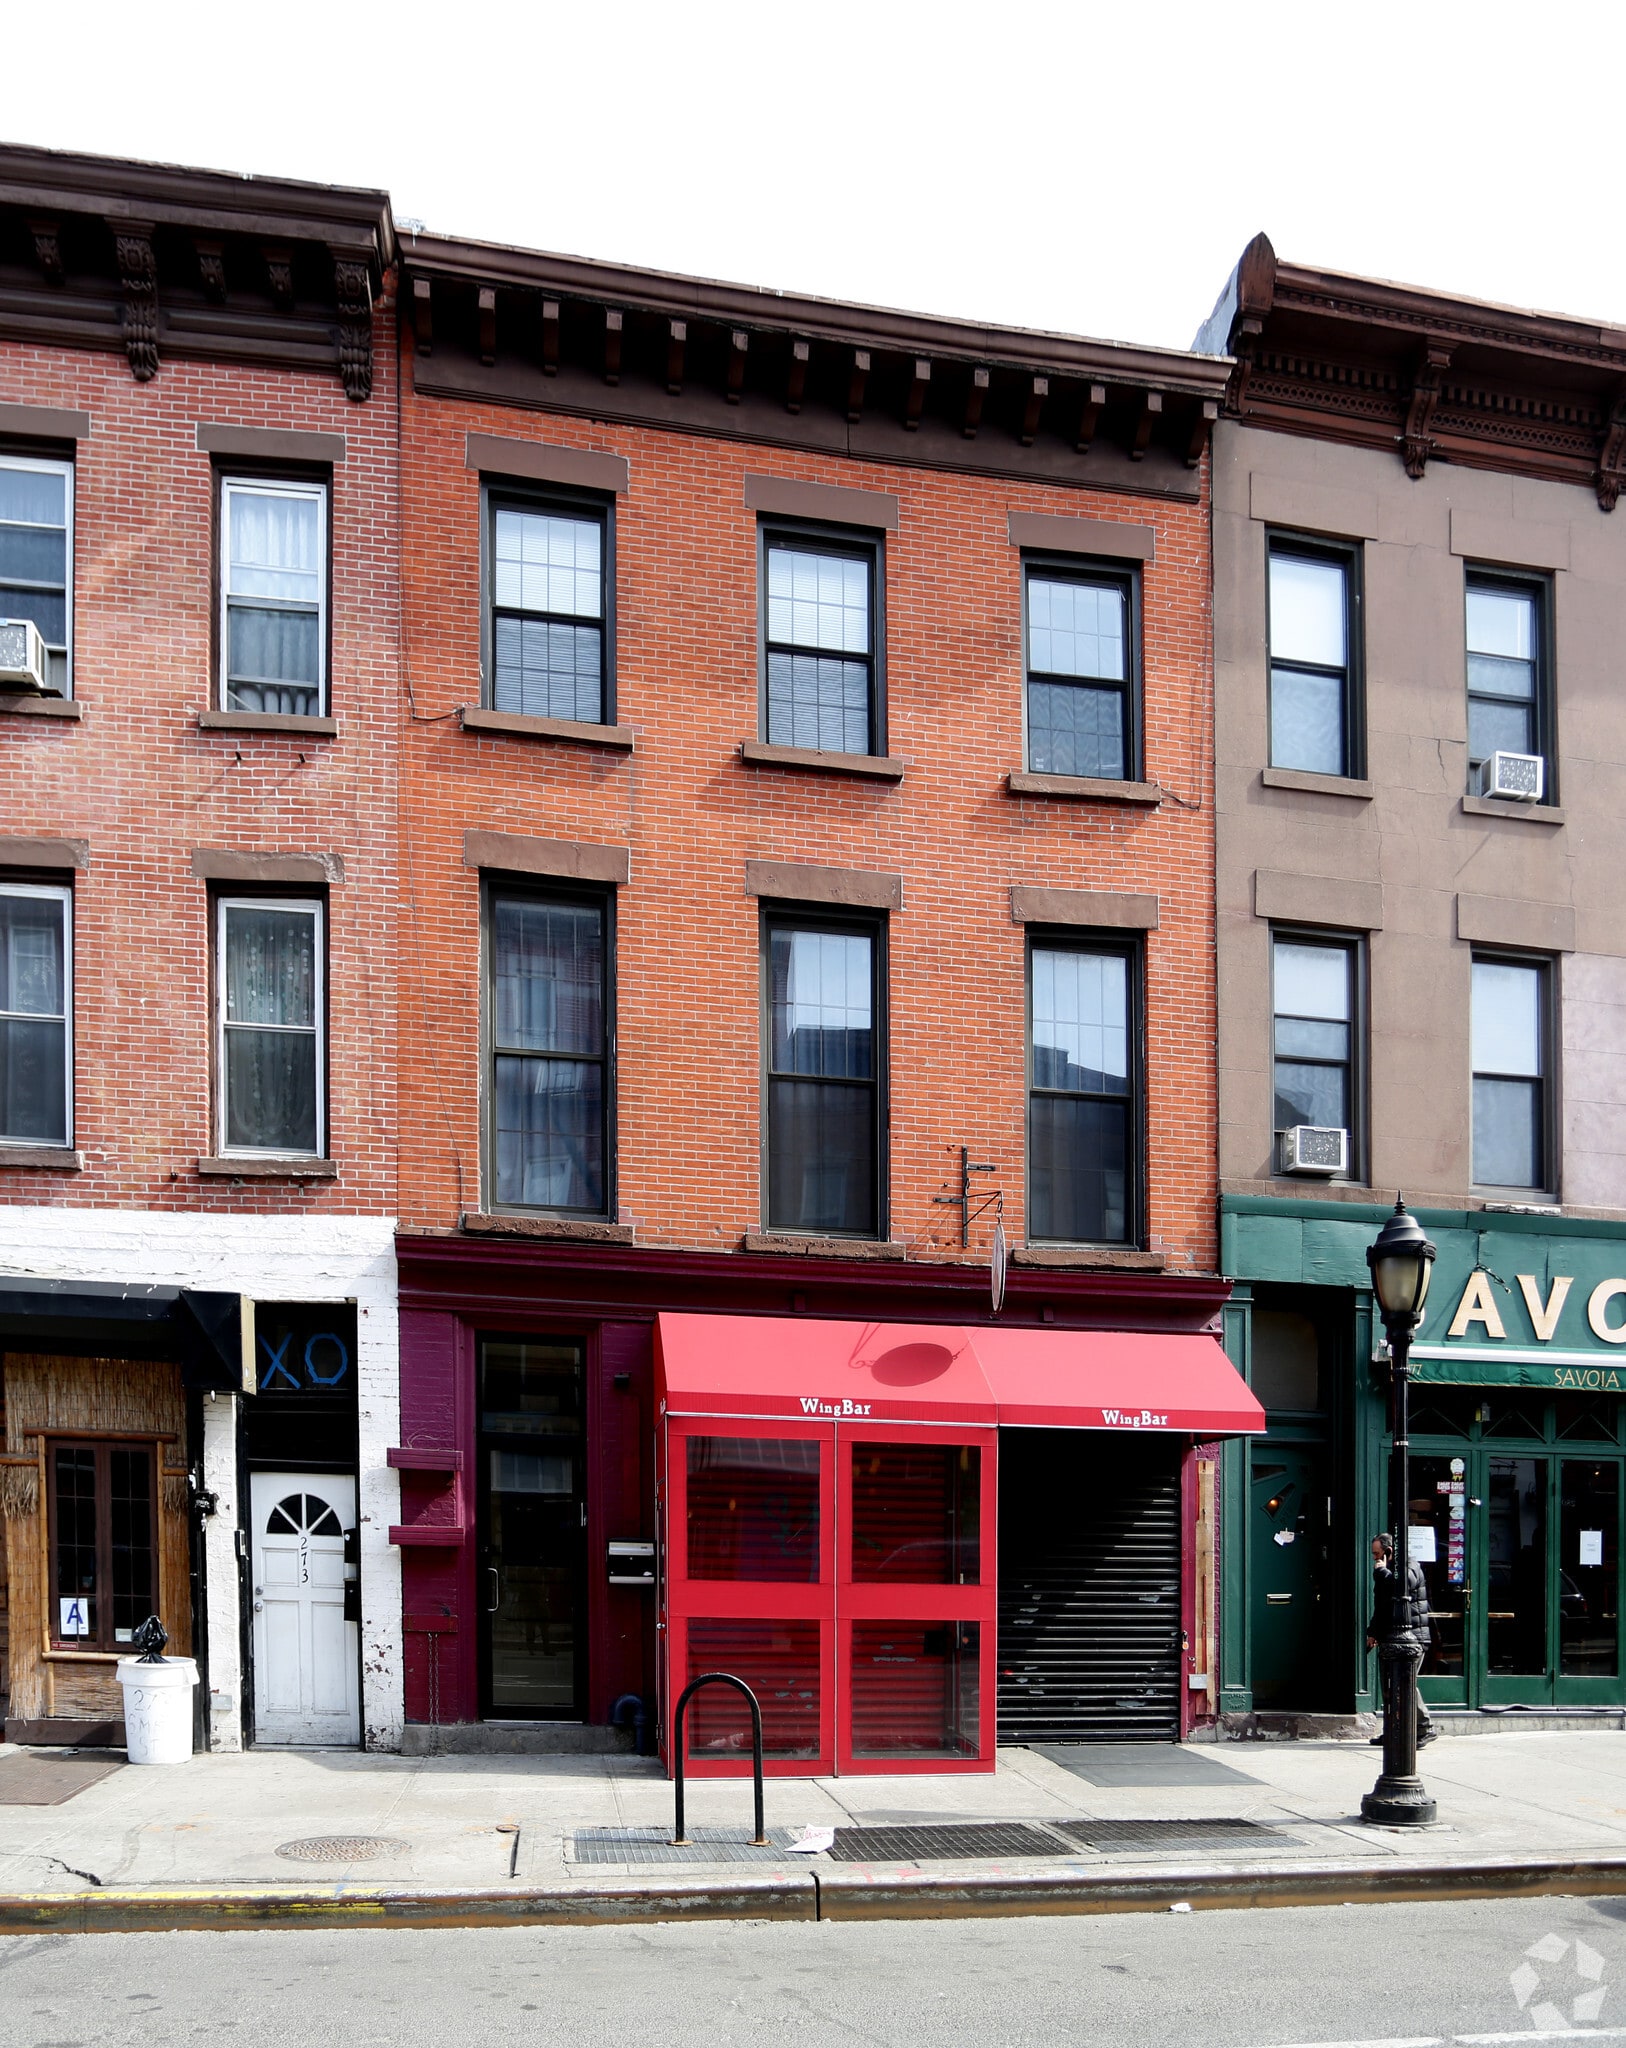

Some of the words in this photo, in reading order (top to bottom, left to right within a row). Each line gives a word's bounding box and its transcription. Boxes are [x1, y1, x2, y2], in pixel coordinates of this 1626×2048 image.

[1414, 1271, 1626, 1344] AVO
[257, 1332, 348, 1389] XO
[1554, 1368, 1620, 1388] SAVOIA
[800, 1397, 871, 1416] WingBar
[1101, 1409, 1168, 1427] WingBar
[300, 1536, 309, 1584] 273
[66, 1603, 84, 1624] A
